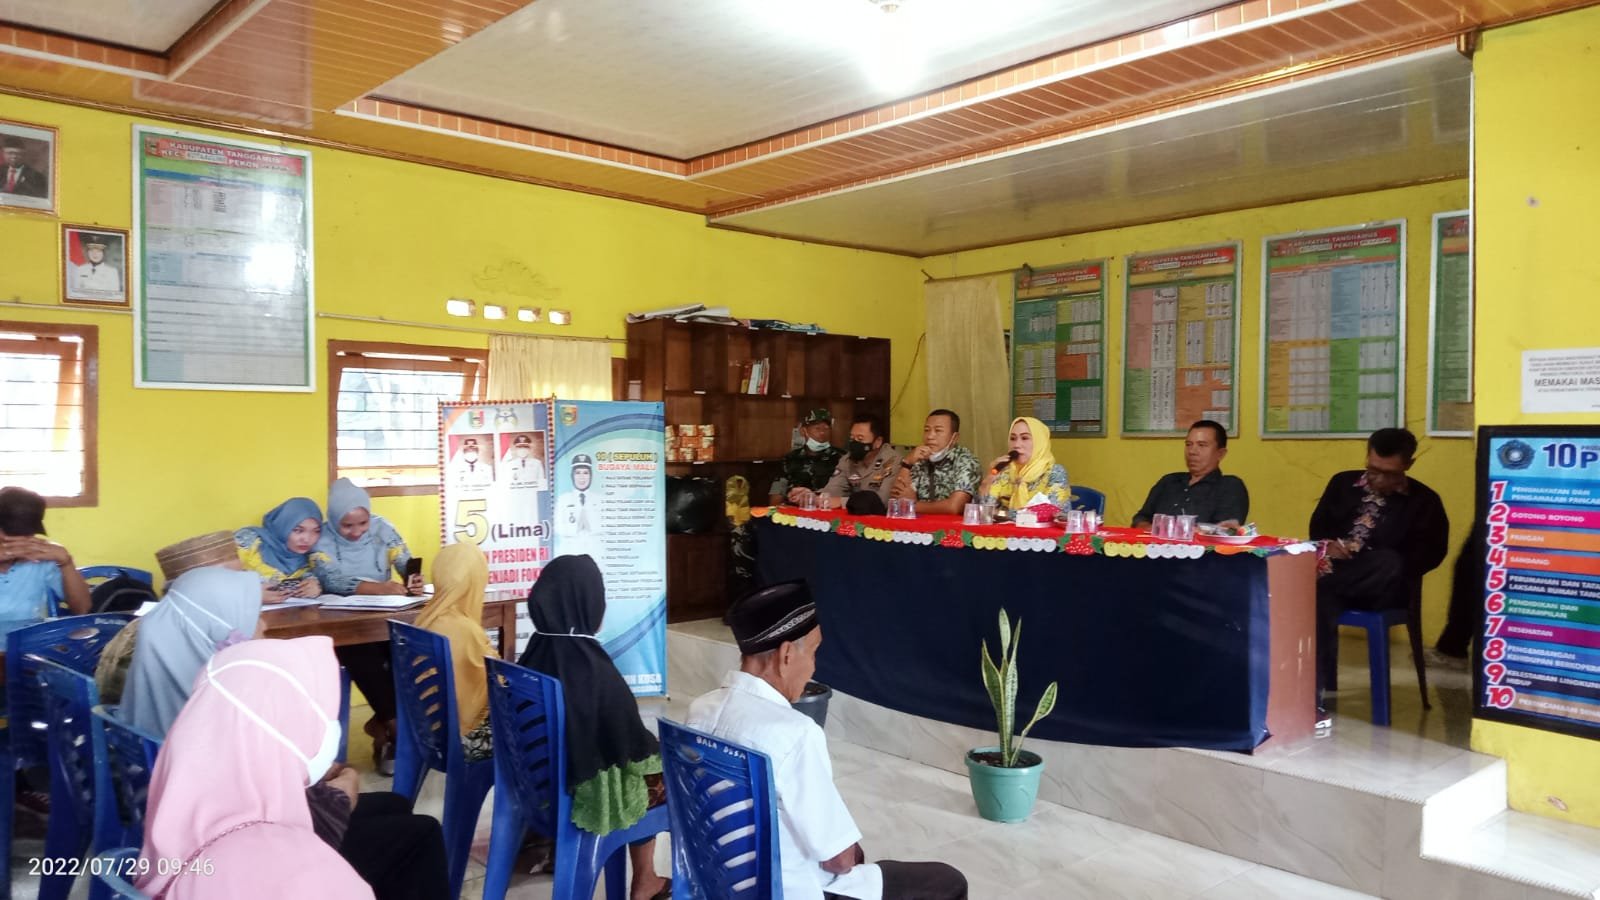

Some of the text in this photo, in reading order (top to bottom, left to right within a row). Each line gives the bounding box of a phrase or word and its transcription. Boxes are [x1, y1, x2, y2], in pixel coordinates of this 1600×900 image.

[1534, 378, 1578, 387] MEMAKAI
[1543, 443, 1577, 468] 10
[1490, 481, 1508, 503] 1
[1486, 502, 1510, 524] 2
[1511, 511, 1546, 520] GOTONG
[491, 520, 550, 542] (Lima)
[1486, 523, 1509, 546] 3
[492, 547, 537, 564] PRESIDEN
[539, 546, 549, 562] RI
[1486, 546, 1508, 569] 4
[488, 567, 544, 585] ENJADI FOK
[1486, 569, 1507, 592] 5
[1509, 575, 1560, 586] PERUMAHAN
[1561, 579, 1580, 588] DAN
[1509, 583, 1546, 593] LAKSANA
[1485, 592, 1507, 615] 6
[1484, 615, 1507, 638] 7
[1483, 638, 1507, 662] 8
[1484, 662, 1507, 685] 9
[1485, 685, 1516, 709] 10
